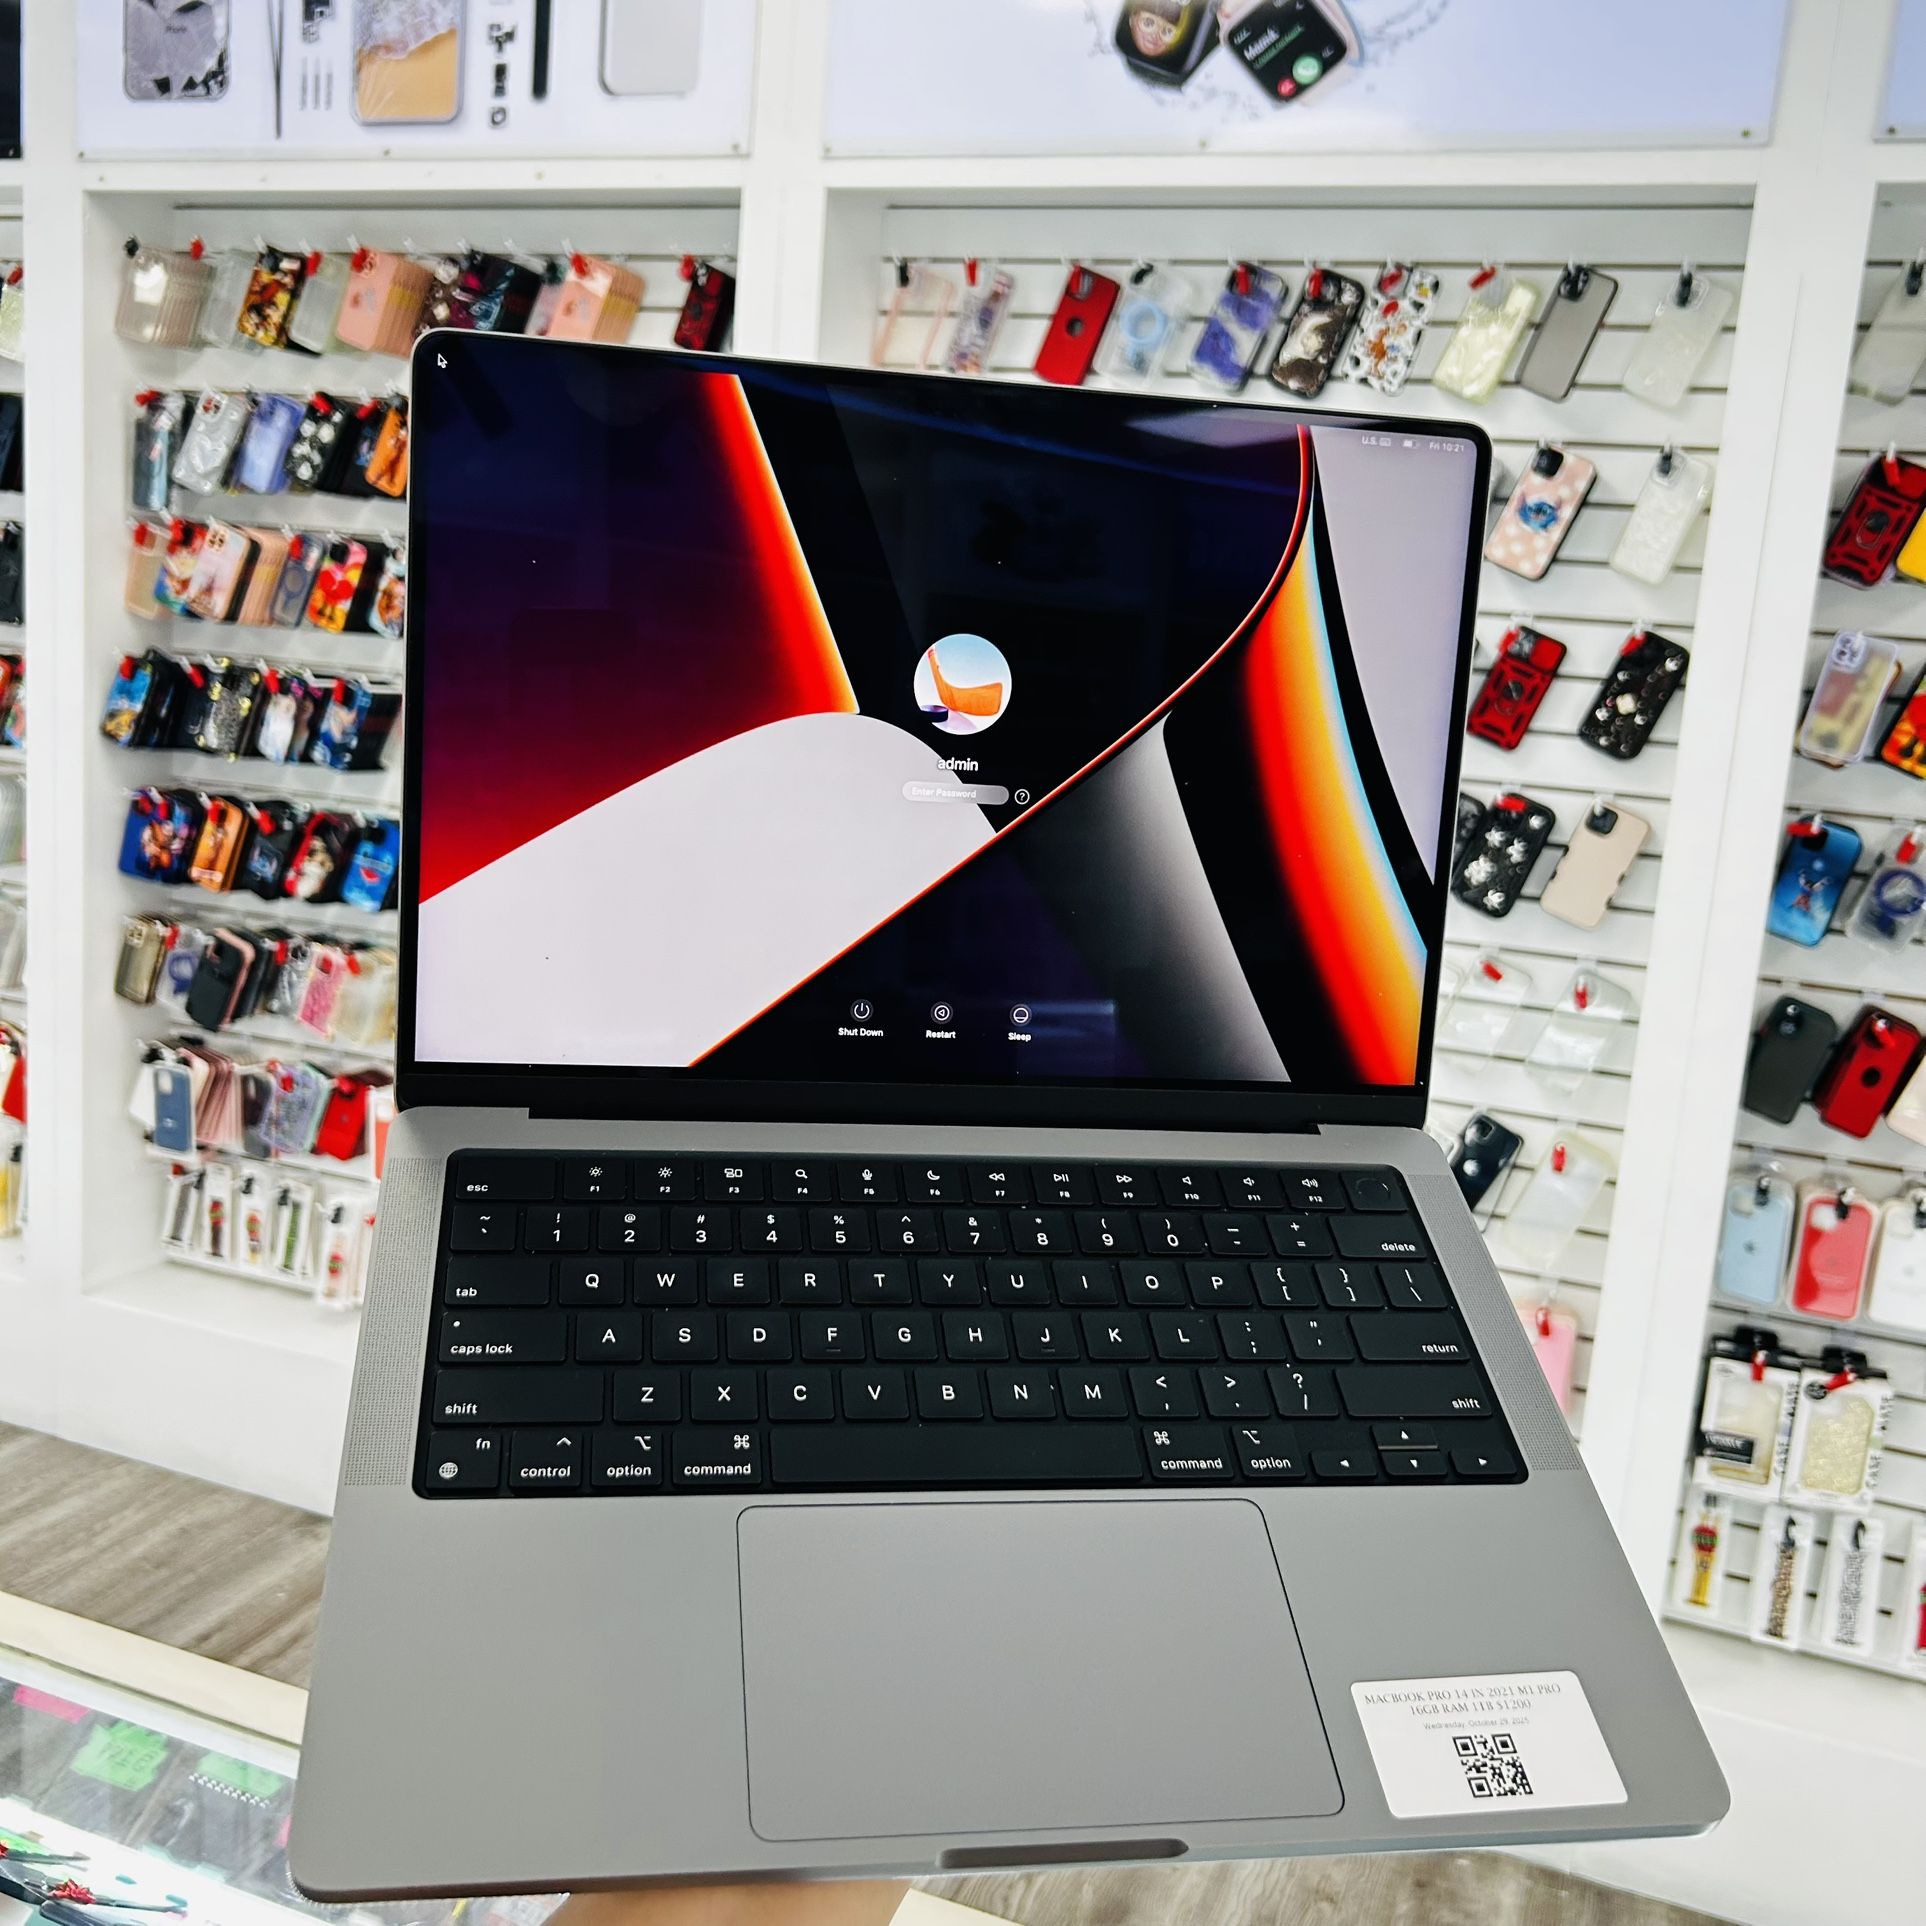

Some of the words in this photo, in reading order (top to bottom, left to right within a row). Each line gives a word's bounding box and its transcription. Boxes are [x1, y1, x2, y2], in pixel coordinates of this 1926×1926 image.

[1361, 435, 1378, 446] U.S.
[1429, 442, 1440, 451] Fri
[1442, 443, 1465, 452] 10:21
[938, 757, 979, 771] admin
[911, 786, 935, 796] Enter
[936, 788, 977, 799] Password
[838, 1027, 858, 1037] Shut
[860, 1027, 884, 1037] Down
[926, 1030, 956, 1039] Restart
[1008, 1032, 1032, 1042] Sleep
[466, 1184, 489, 1192] esc
[556, 1212, 561, 1223] !
[624, 1213, 636, 1223] @
[696, 1214, 705, 1223] #
[767, 1214, 775, 1225] $
[833, 1215, 844, 1225] %
[901, 1215, 911, 1223] ^
[968, 1216, 978, 1227] &
[1101, 1217, 1107, 1229] (
[1164, 1218, 1171, 1230] )
[1290, 1222, 1300, 1232] +
[553, 1229, 561, 1242] 1
[624, 1230, 635, 1243] 2
[695, 1230, 707, 1243] 3
[766, 1230, 778, 1243] 4
[835, 1231, 847, 1244] 5
[902, 1231, 915, 1245] 6
[969, 1232, 980, 1245] 7
[1036, 1232, 1049, 1246] 8
[1101, 1233, 1114, 1247] 9
[1166, 1234, 1179, 1248] 0
[1381, 1242, 1416, 1252] delete
[585, 1273, 600, 1289] Q
[656, 1273, 676, 1288] W
[733, 1273, 744, 1288] E
[804, 1273, 817, 1288] R
[873, 1273, 886, 1288] T
[942, 1273, 955, 1288] Y
[1010, 1274, 1025, 1289] U
[1081, 1275, 1088, 1289] I
[1276, 1267, 1286, 1283] {
[1338, 1267, 1349, 1284] }
[1144, 1275, 1160, 1290] O
[1211, 1276, 1224, 1290] P
[456, 1286, 478, 1297] tab
[1281, 1285, 1292, 1301] [
[1345, 1286, 1357, 1302] ]
[1409, 1286, 1422, 1302] \
[1245, 1321, 1251, 1332] :
[1309, 1320, 1318, 1328] "
[602, 1328, 616, 1344] A
[678, 1327, 692, 1344] S
[753, 1327, 767, 1343] D
[827, 1327, 838, 1342] F
[897, 1327, 912, 1343] G
[968, 1327, 983, 1343] H
[1040, 1327, 1051, 1343] J
[1108, 1327, 1123, 1343] K
[1177, 1328, 1191, 1344] L
[450, 1344, 482, 1356] caps
[485, 1342, 513, 1354] lock
[1251, 1340, 1257, 1354] ;
[1421, 1343, 1459, 1353] return
[1155, 1375, 1168, 1389] <
[1223, 1375, 1237, 1388] >
[1292, 1372, 1304, 1389] ?
[640, 1386, 654, 1403] Z
[717, 1385, 731, 1402] X
[793, 1384, 807, 1402] C
[867, 1384, 882, 1401] V
[941, 1384, 956, 1401] B
[1013, 1384, 1029, 1400] N
[1084, 1384, 1102, 1400] M
[444, 1402, 478, 1415] shift
[1451, 1397, 1481, 1409] shift
[475, 1437, 491, 1450] fn
[683, 1462, 752, 1476] command
[1160, 1458, 1223, 1471] command
[1250, 1456, 1292, 1471] option
[520, 1465, 571, 1479] control
[606, 1464, 653, 1478] option
[1364, 1691, 1425, 1704] MACBOOK
[1427, 1689, 1451, 1701] PRO
[1455, 1689, 1469, 1699] 14
[1471, 1687, 1485, 1697] IN
[1488, 1686, 1515, 1697] 2021
[1517, 1684, 1534, 1696] M1
[1537, 1683, 1561, 1694] PRO
[1411, 1704, 1440, 1716] 16GB
[1442, 1702, 1470, 1713] RAM
[1468, 1719, 1498, 1728] October
